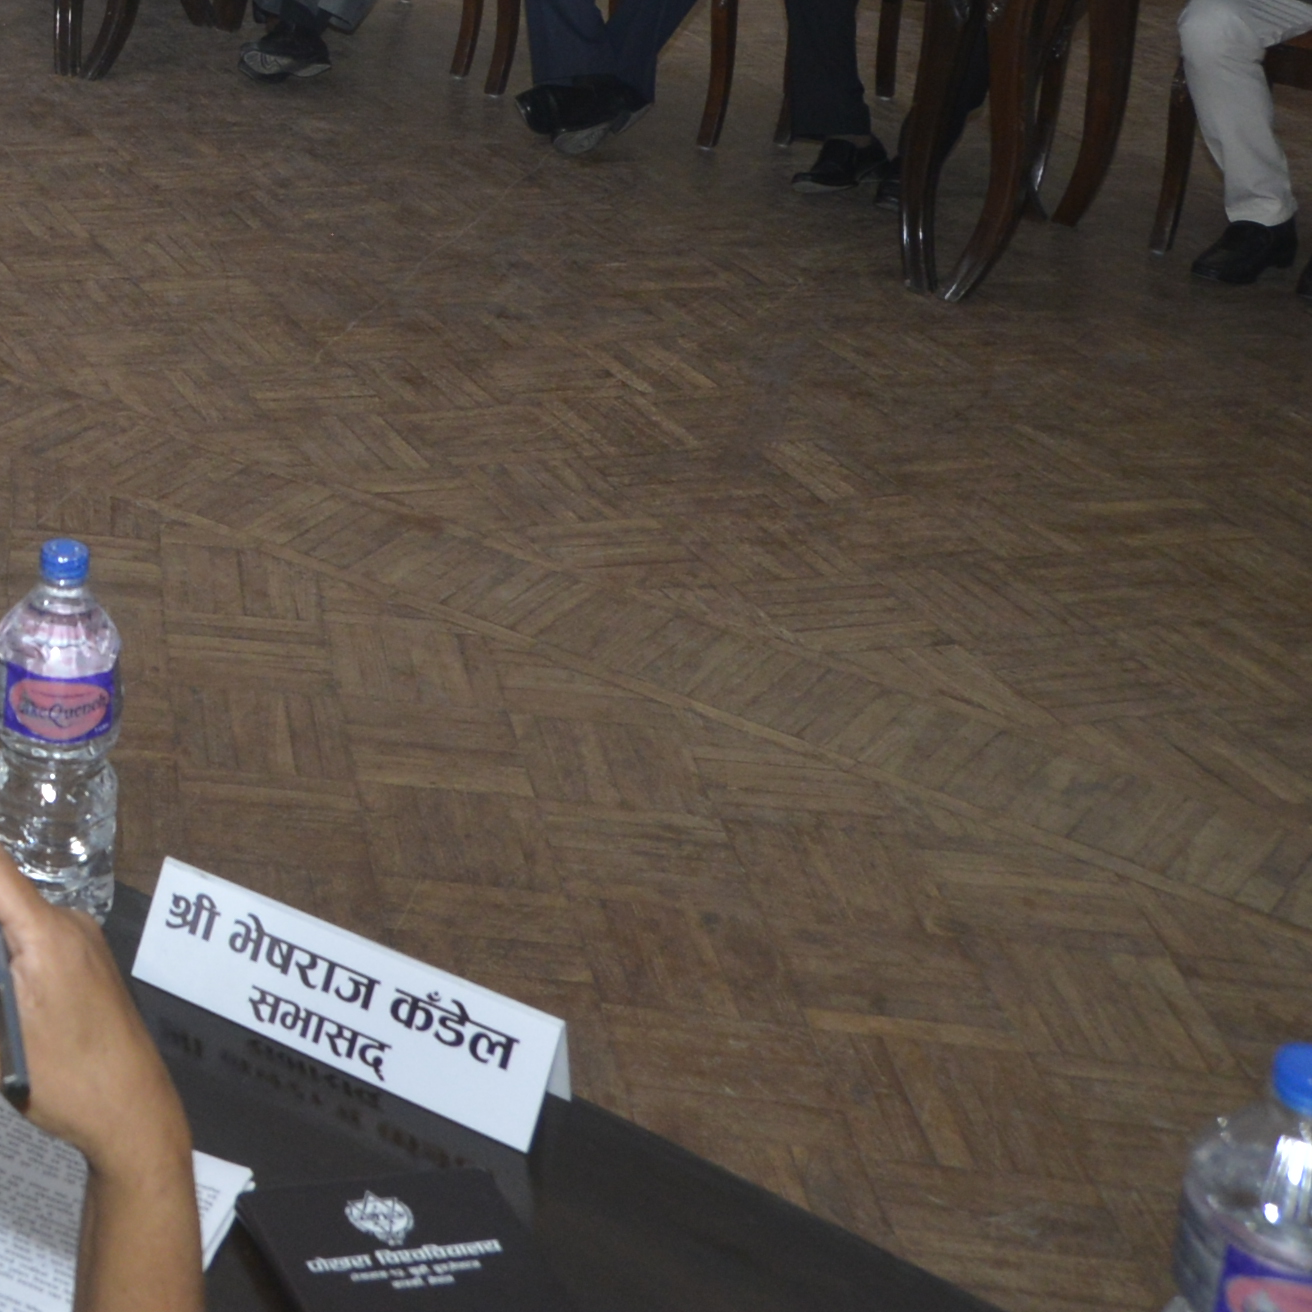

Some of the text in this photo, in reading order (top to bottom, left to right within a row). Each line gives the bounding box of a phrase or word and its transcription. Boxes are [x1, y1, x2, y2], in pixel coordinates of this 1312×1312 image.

[164, 892, 520, 1071] श्री भेषराज कँडेल
[248, 984, 393, 1082] सभासद
